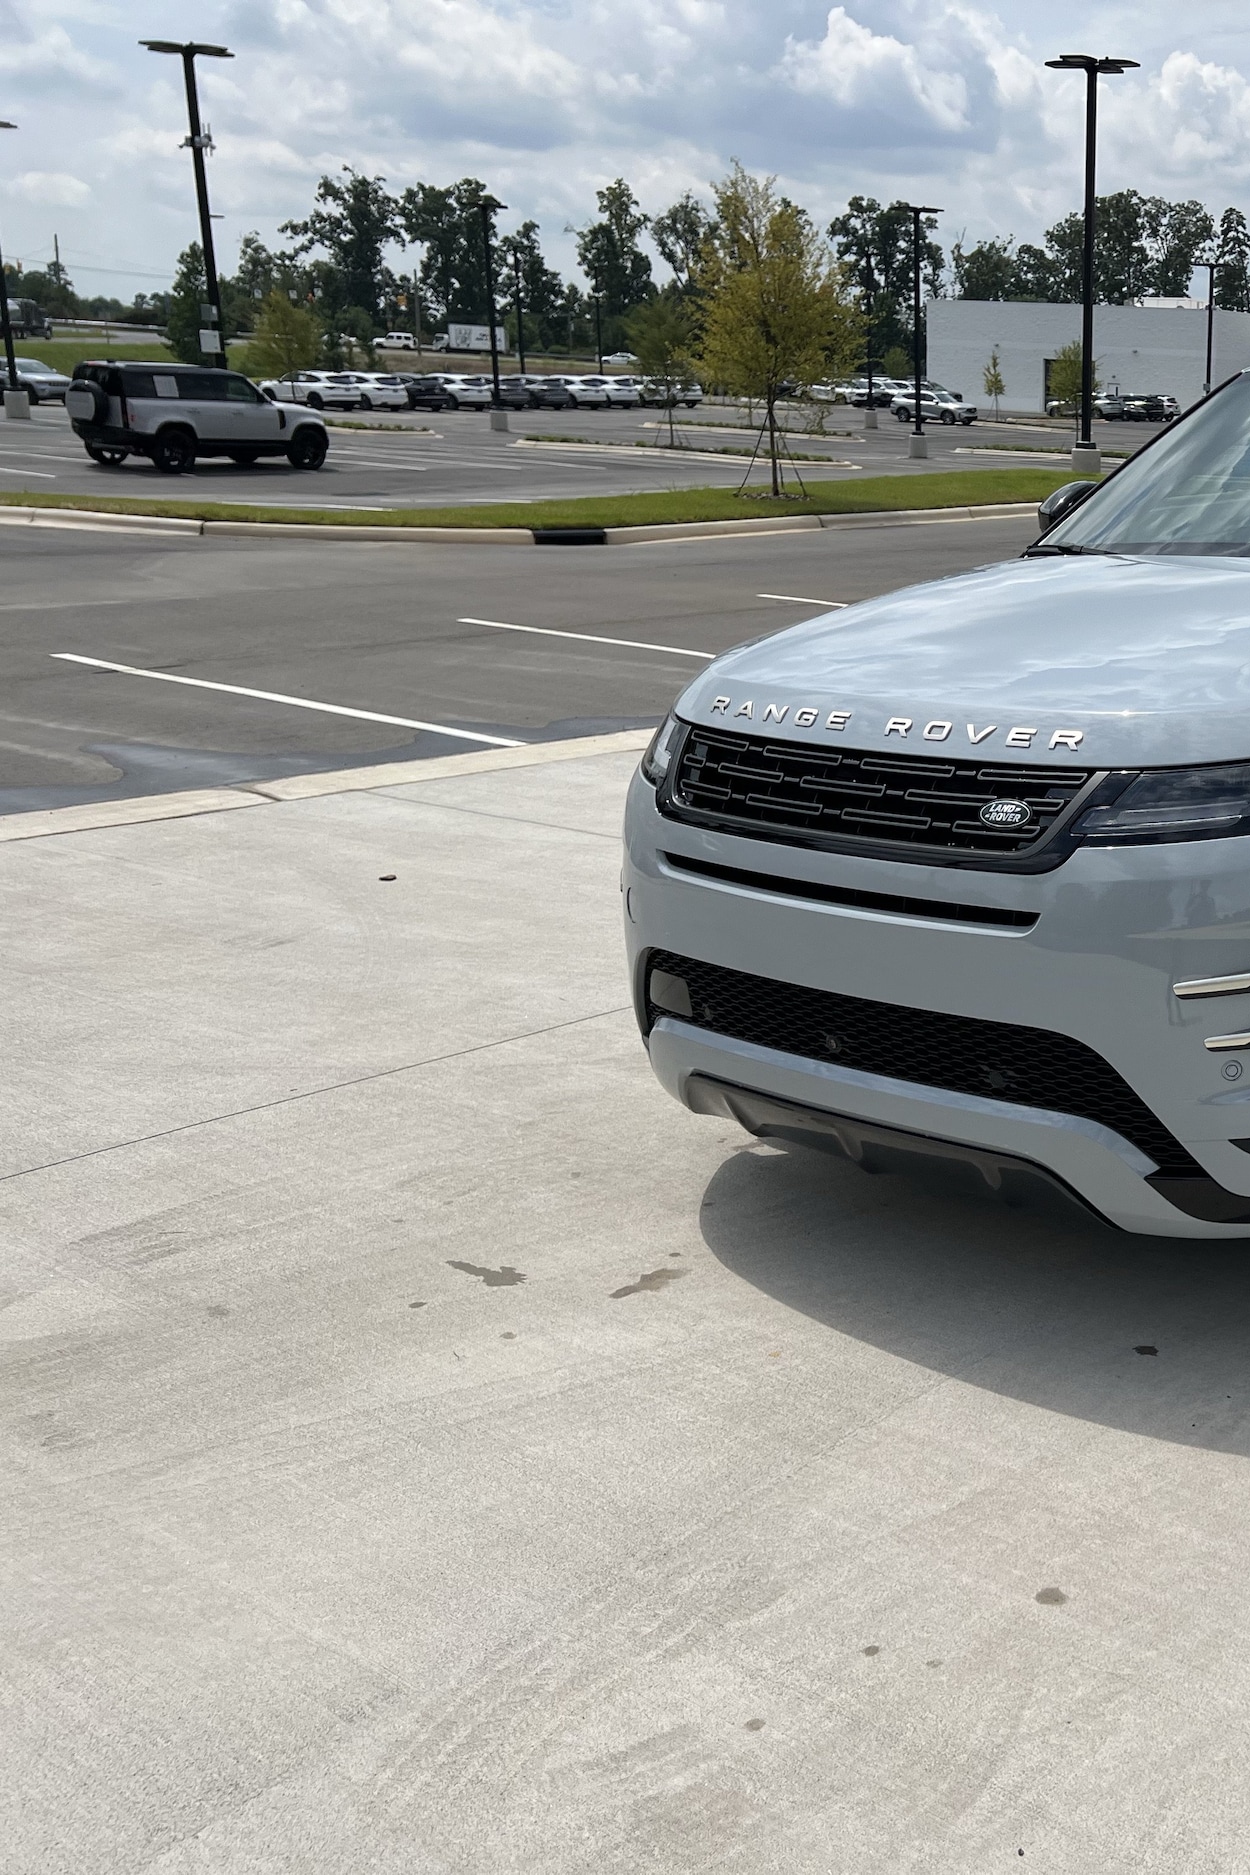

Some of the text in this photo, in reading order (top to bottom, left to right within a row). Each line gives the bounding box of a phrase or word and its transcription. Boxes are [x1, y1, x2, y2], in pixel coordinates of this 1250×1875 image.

[710, 695, 1084, 752] RANGE ROVER
[989, 803, 1016, 813] LAND
[989, 812, 1021, 822] ROVER
